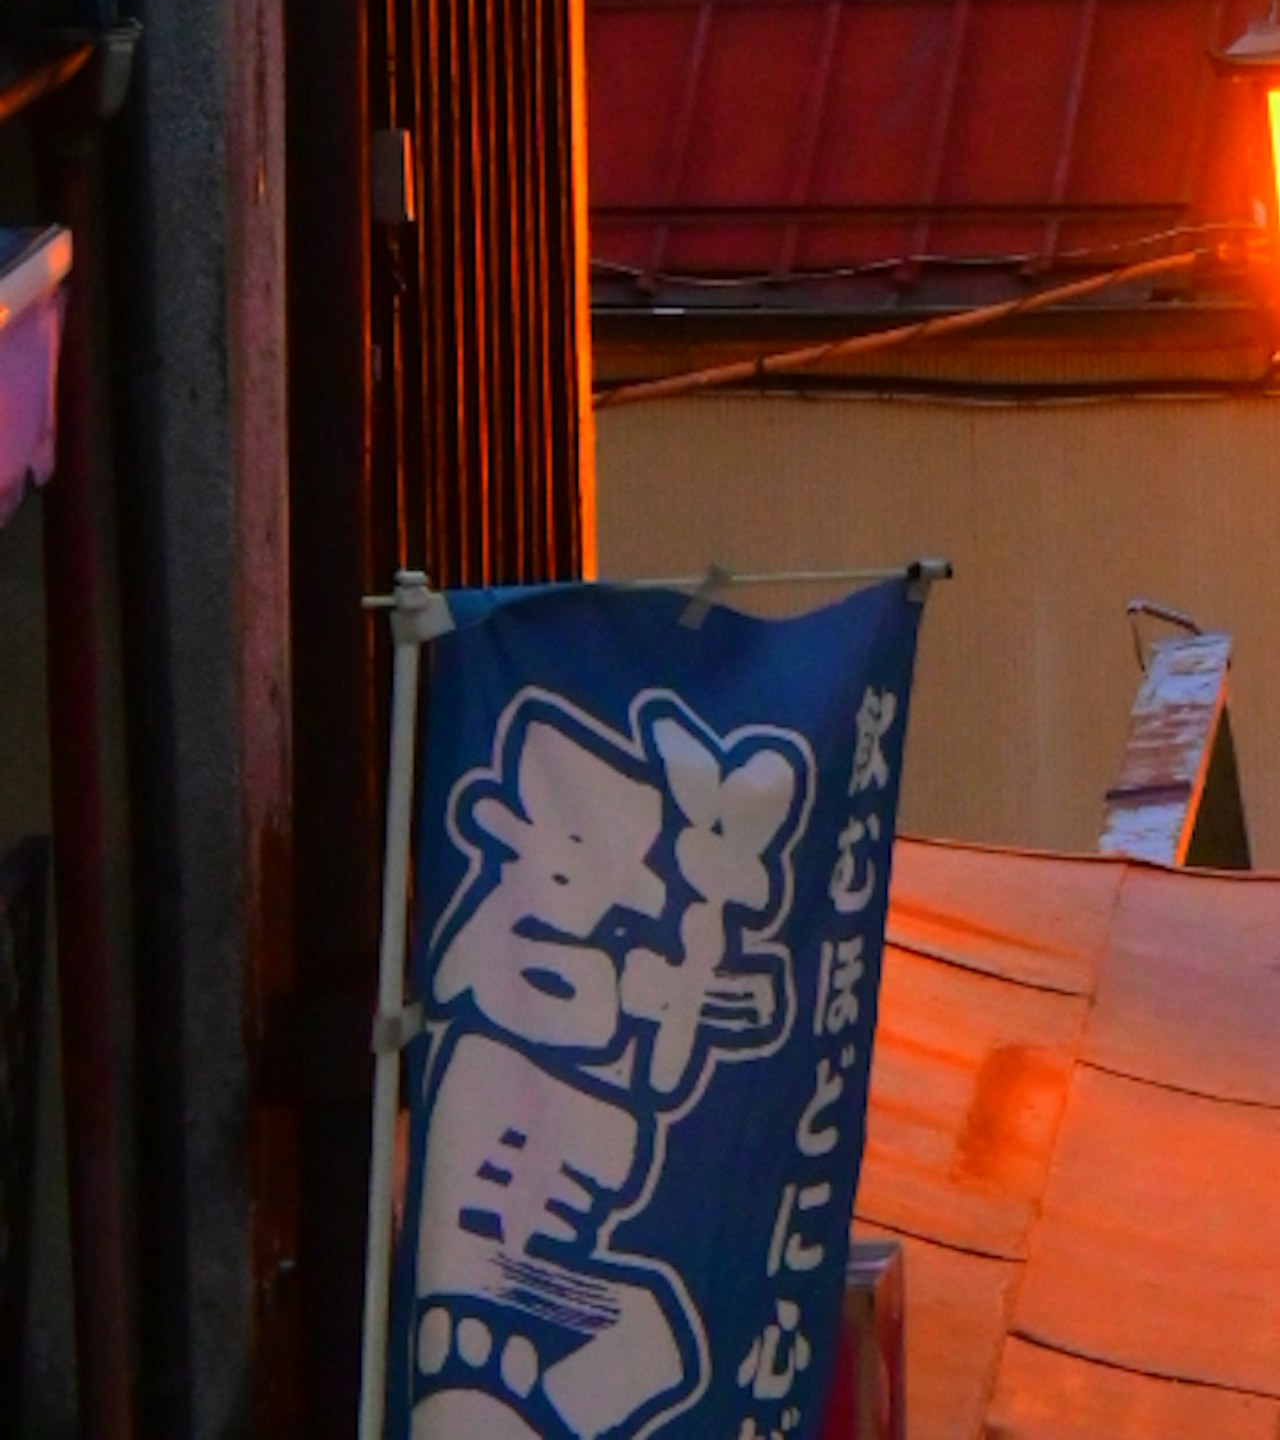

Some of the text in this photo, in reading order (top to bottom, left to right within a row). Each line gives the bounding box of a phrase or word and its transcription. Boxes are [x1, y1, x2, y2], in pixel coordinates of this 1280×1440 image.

[412, 710, 792, 1440] 群馬
[735, 685, 897, 1440] 飲むほどに心
